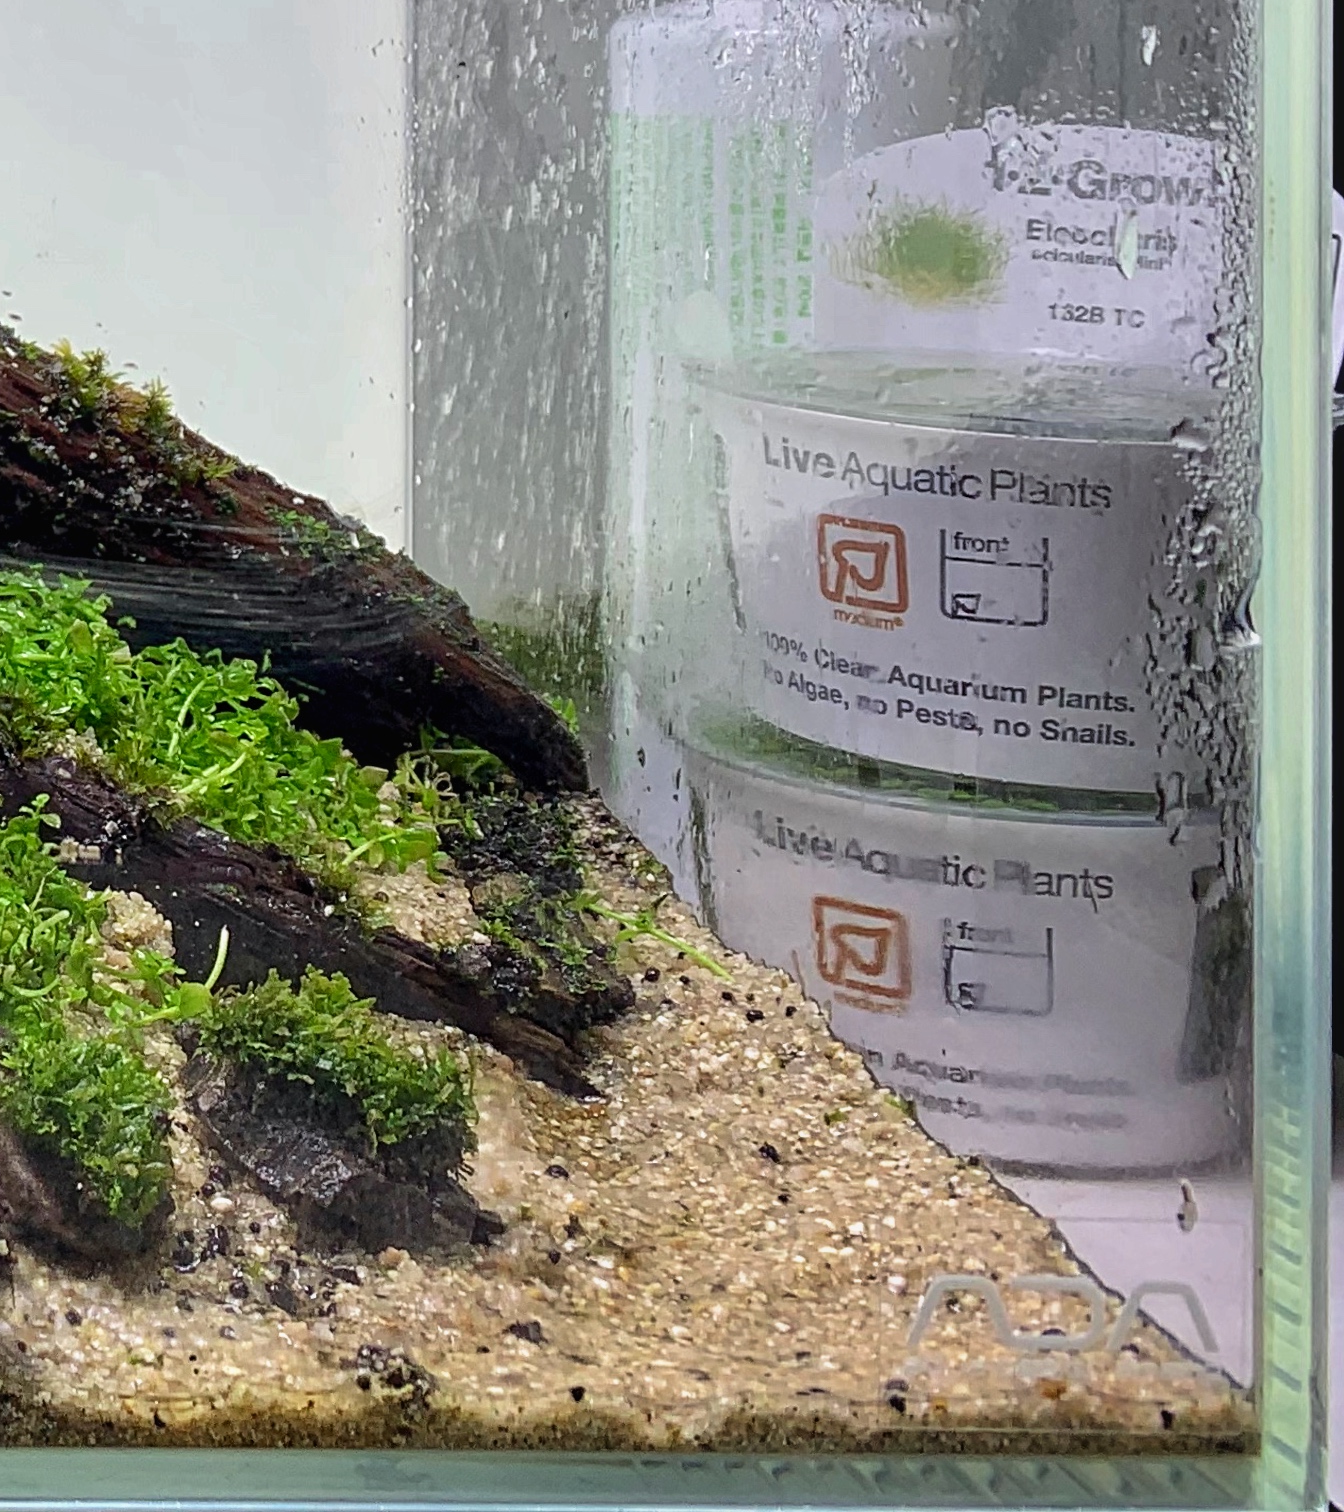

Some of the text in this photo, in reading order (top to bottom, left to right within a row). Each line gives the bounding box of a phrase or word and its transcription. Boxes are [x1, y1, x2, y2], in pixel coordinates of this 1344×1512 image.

[1026, 217, 1178, 255] Eleocris
[1115, 308, 1146, 329] TC
[762, 436, 1113, 509] Live Aquatic Plants
[954, 532, 1010, 554] front
[764, 630, 808, 663] 100%
[814, 647, 879, 679] Clear
[1039, 685, 1136, 713] Plants.
[788, 669, 850, 711] Algae,
[994, 717, 1031, 738] no
[1040, 718, 1136, 747] Snails.
[844, 836, 987, 890] Aqtic
